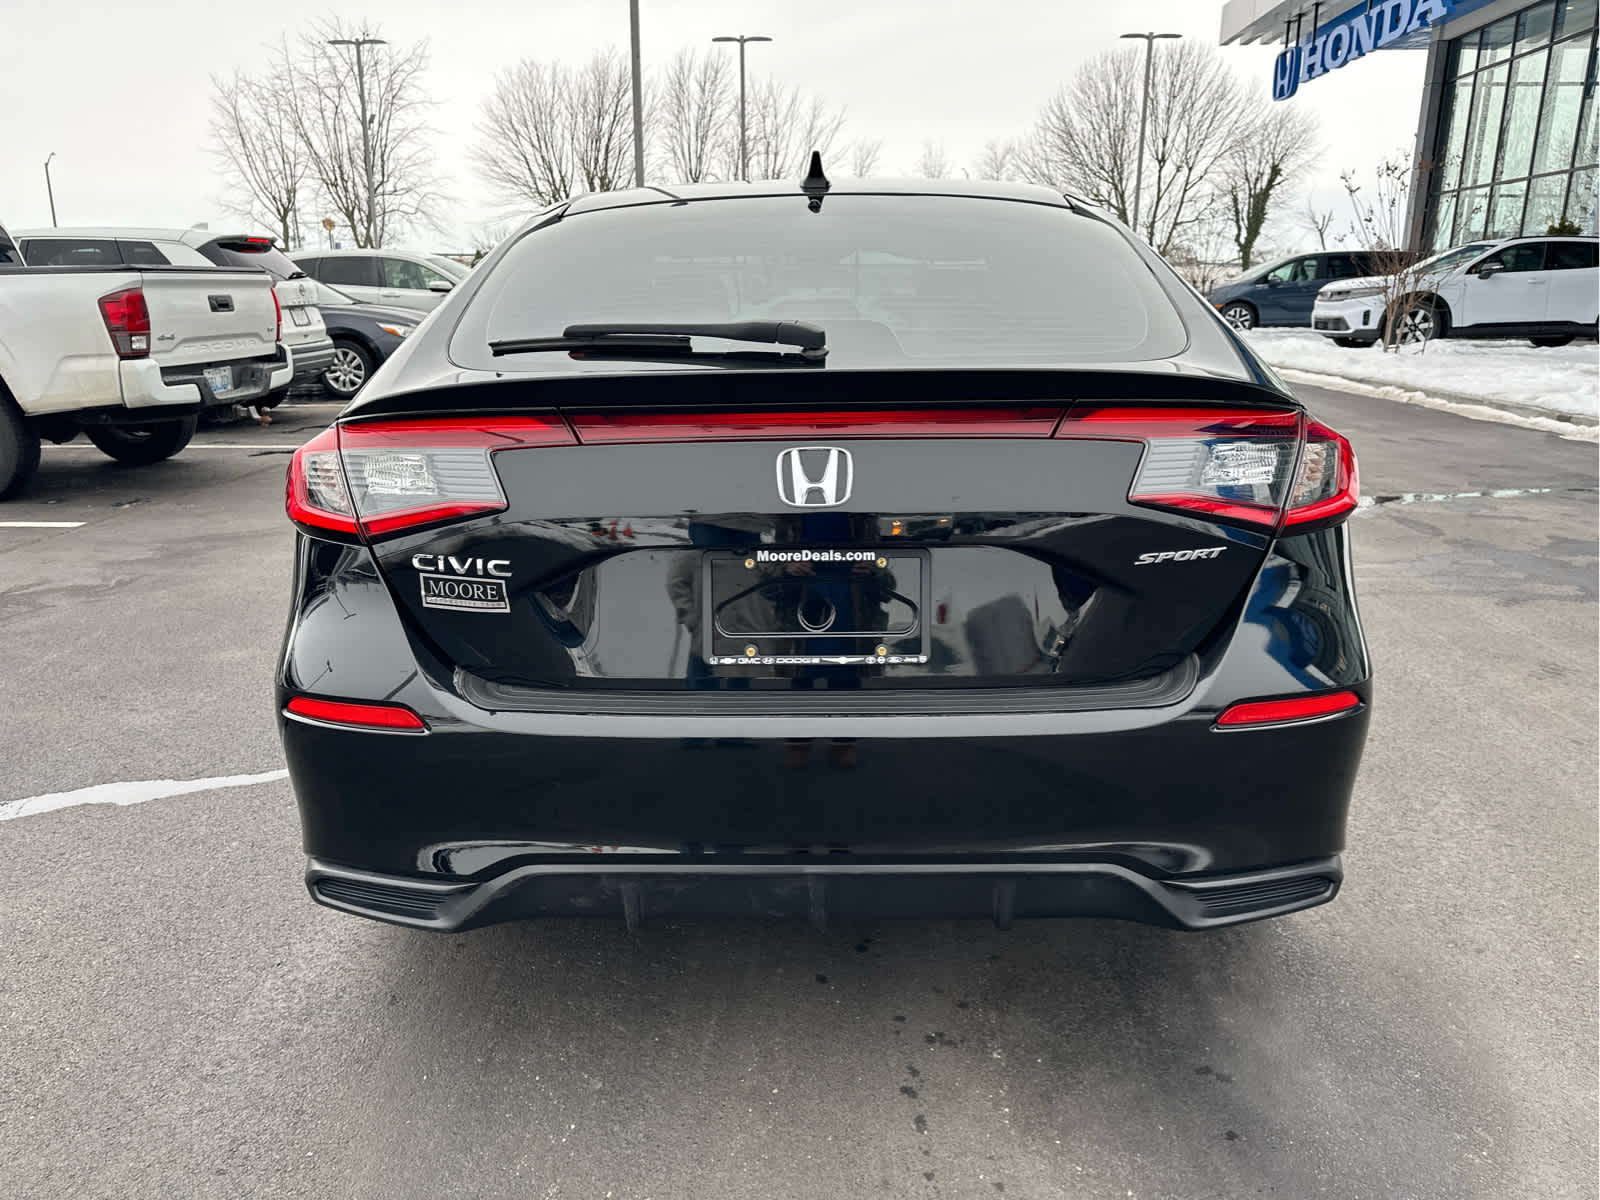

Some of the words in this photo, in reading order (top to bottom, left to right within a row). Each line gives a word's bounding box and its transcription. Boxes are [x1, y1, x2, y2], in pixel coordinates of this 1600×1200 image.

[1299, 0, 1447, 83] HONDA
[756, 549, 876, 563] MooreDeals.com
[1133, 546, 1228, 566] SPORT
[428, 580, 499, 600] MOORE
